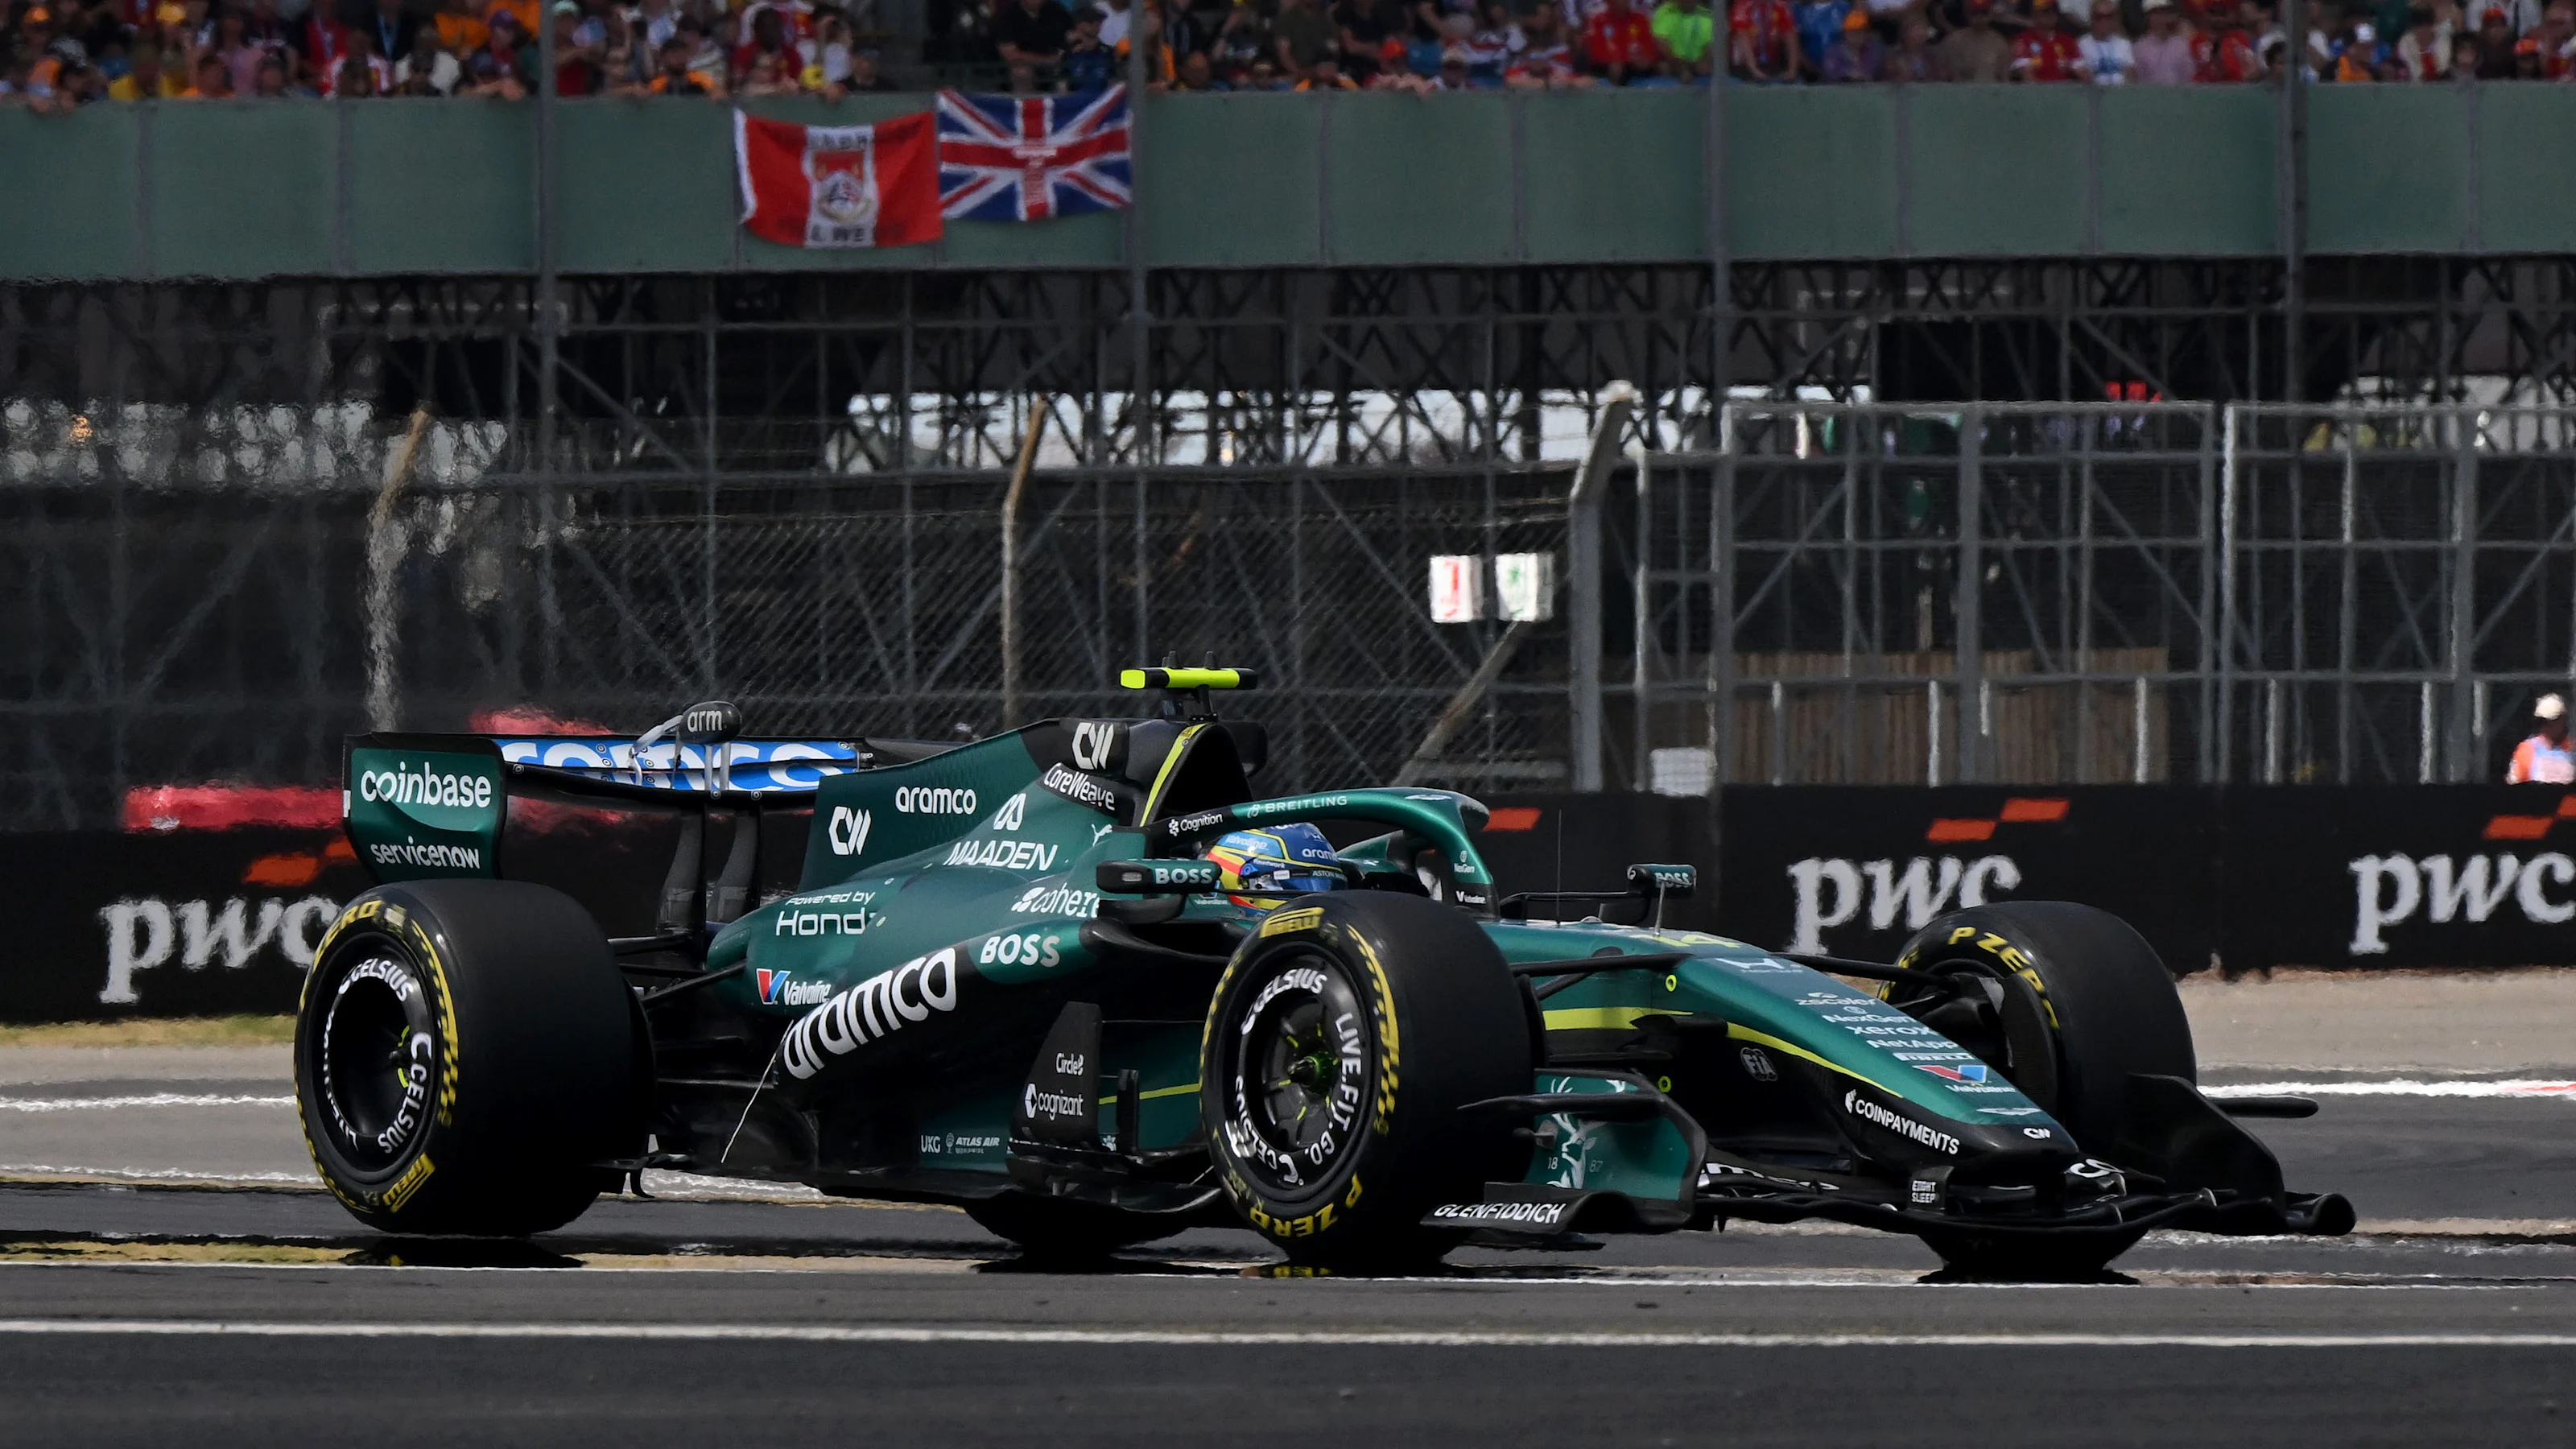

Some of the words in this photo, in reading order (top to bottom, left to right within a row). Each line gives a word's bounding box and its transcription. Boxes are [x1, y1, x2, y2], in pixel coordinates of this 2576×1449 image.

[687, 707, 723, 733] arm
[360, 761, 492, 808] coinbase
[1044, 762, 1116, 811] CoreWeave
[895, 786, 977, 815] aramco
[1265, 796, 1348, 813] BREITLING
[1180, 813, 1224, 832] Cognition
[370, 836, 481, 870] servicenow
[943, 840, 1058, 871] MAADEN
[1155, 868, 1212, 885] BOSS
[785, 892, 849, 906] Powered
[854, 890, 876, 905] by
[2348, 852, 2576, 955] pwc
[776, 907, 877, 935] Hond
[95, 894, 343, 1005] pwc
[980, 934, 1060, 967] BOSS
[350, 957, 414, 1002] CELSIUS
[784, 980, 831, 1006] Valvoline
[1253, 968, 1328, 1013] CELSIUS
[783, 947, 956, 1080] aramco
[1846, 1026, 1940, 1036] xerox
[1867, 1039, 1961, 1049] NetApp
[378, 1063, 428, 1154] CELSIUS
[1038, 1089, 1084, 1121] cognizant
[1856, 1098, 1959, 1155] COINPAYMENTS
[921, 1135, 940, 1154] UKG
[956, 1137, 983, 1146] ATLAS
[983, 1137, 1000, 1146] AIR
[1548, 1157, 1558, 1170] 18
[1912, 1192, 1936, 1203] SLEEP
[1250, 1203, 1338, 1237] ZERO
[1434, 1203, 1567, 1224] GLENFIDDICH
